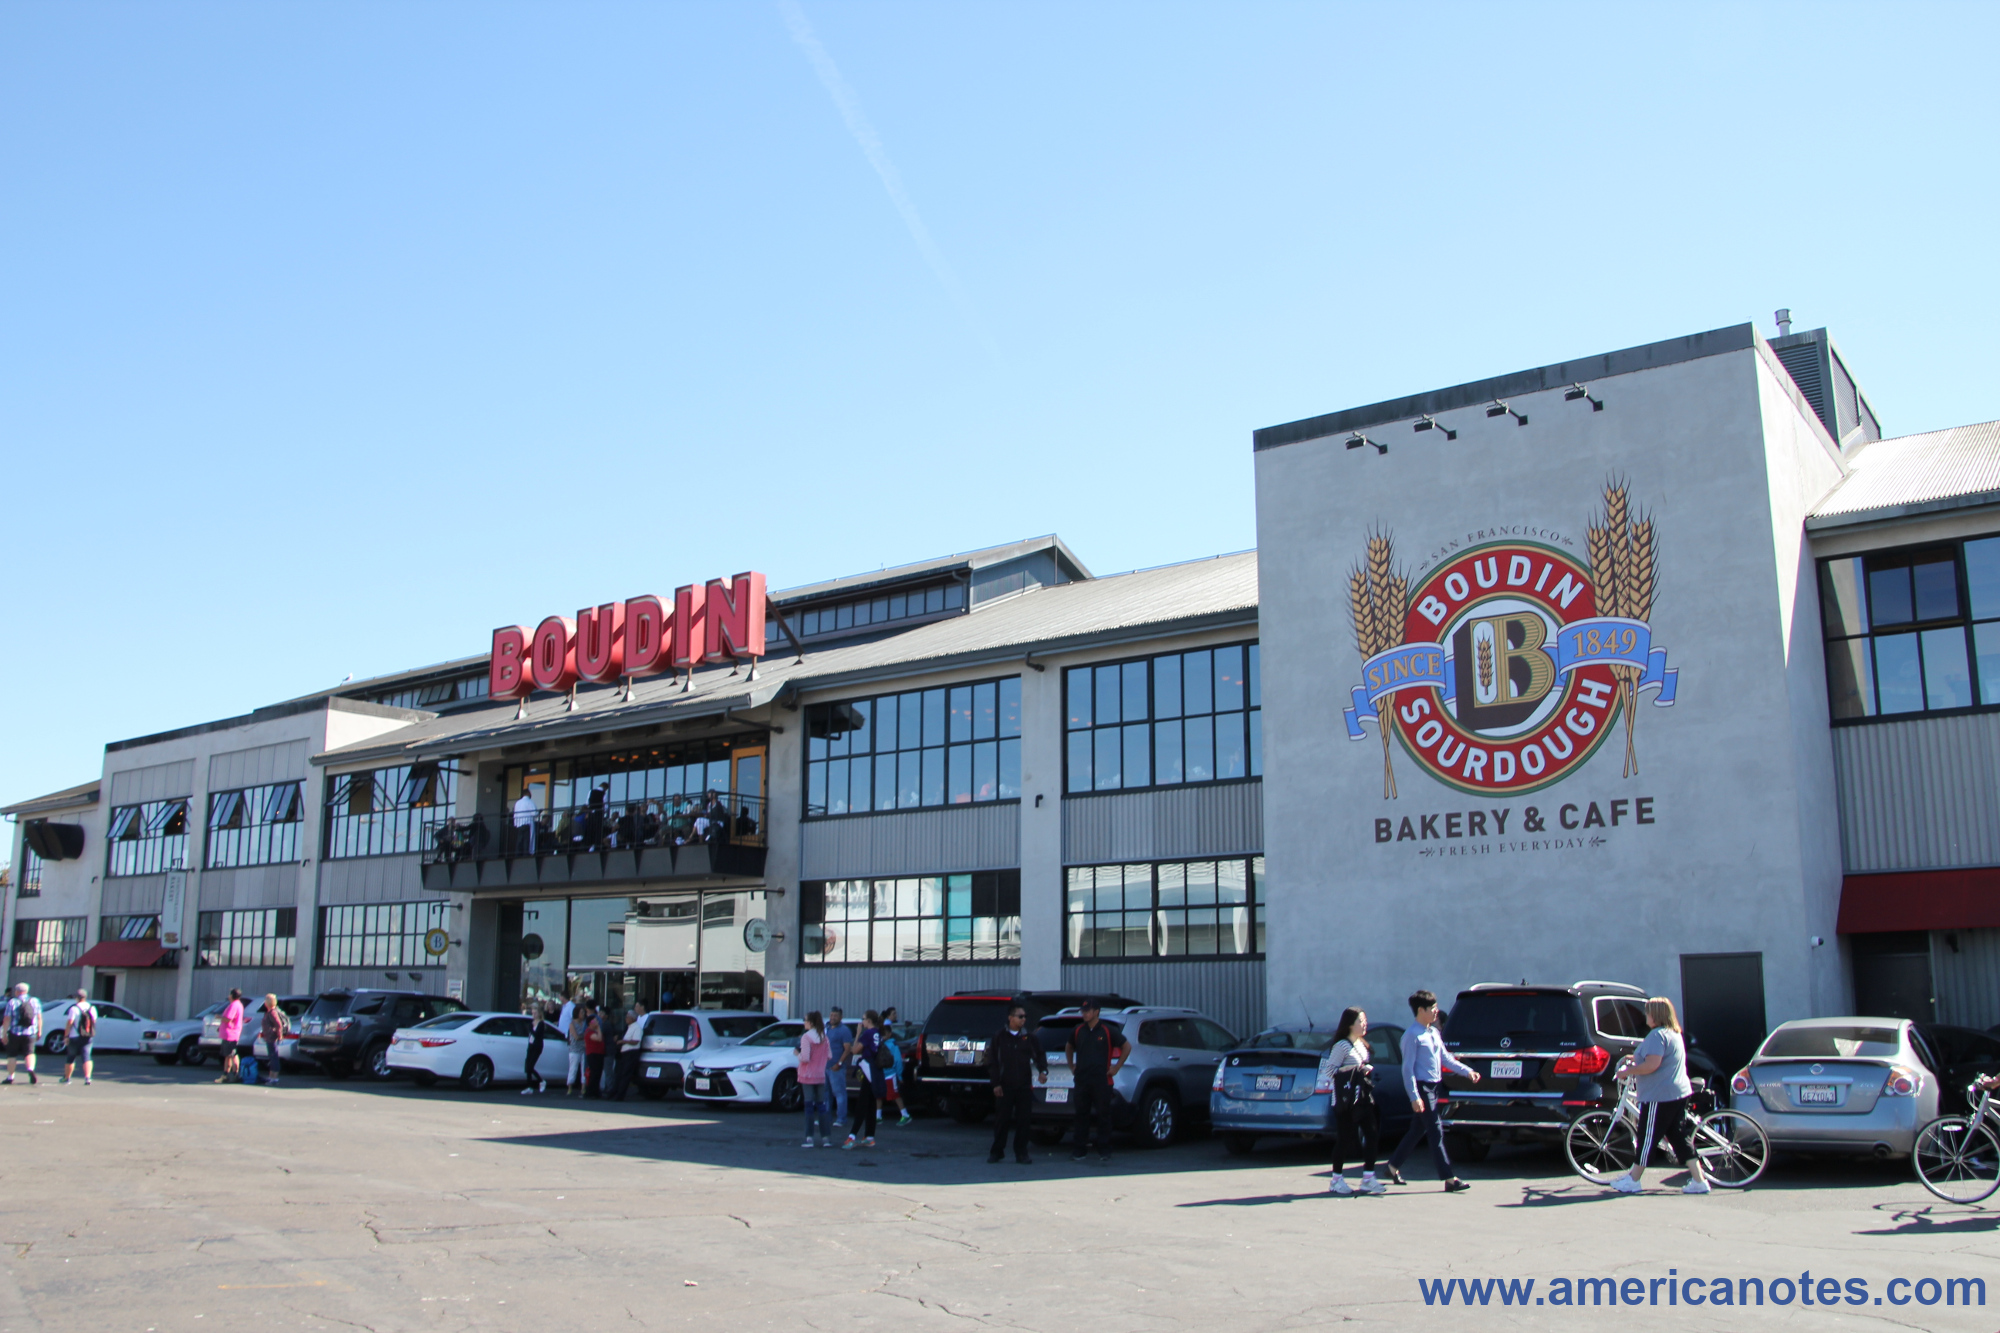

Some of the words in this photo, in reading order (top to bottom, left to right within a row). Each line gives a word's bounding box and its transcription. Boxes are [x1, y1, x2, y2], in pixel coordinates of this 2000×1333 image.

[1431, 539, 1459, 561] SAN
[1467, 525, 1560, 543] FRANCISCO
[1416, 554, 1585, 626] BOUDIN
[488, 570, 766, 699] BOUDIN
[1572, 628, 1637, 658] 1849
[1368, 652, 1441, 691] SINCE
[1401, 678, 1613, 782] SOURDOUGH
[1374, 808, 1510, 843] BAKERY
[1523, 806, 1546, 832] &
[1559, 797, 1656, 830] CAFE
[1439, 844, 1490, 857] FRESH
[1499, 837, 1585, 853] EVERYDAY
